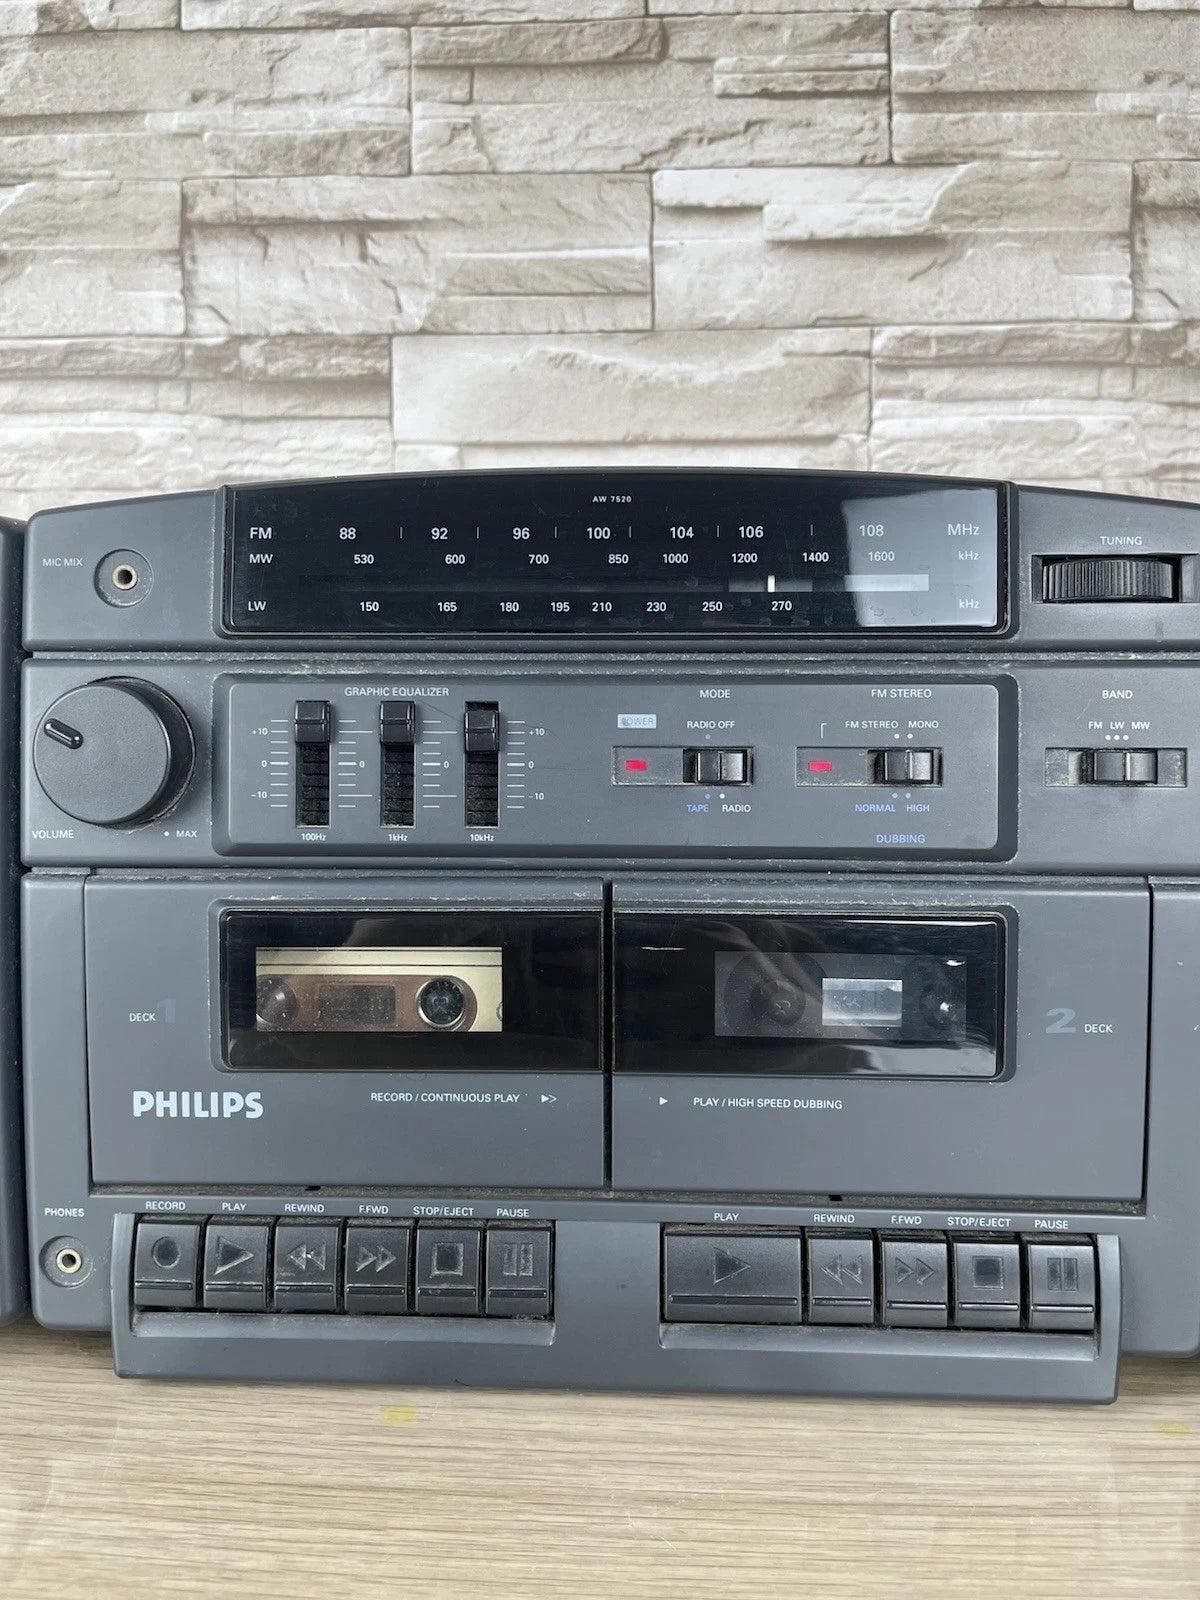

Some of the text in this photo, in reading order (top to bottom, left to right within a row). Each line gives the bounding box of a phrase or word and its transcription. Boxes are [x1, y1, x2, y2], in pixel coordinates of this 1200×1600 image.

[593, 495, 632, 503] AW 7520
[250, 524, 979, 539] FM 88 92 96 100 104 106 108 MHz
[1100, 536, 1142, 546] TUNING
[43, 557, 83, 567] MIC MIX
[250, 550, 981, 564] MW 530 600 700 850 1000 1200 1400 1600 kHz
[248, 598, 980, 612] LW 150 165 180 195 210 230 250 270 kHz
[345, 686, 450, 697] GRAPHIC EQUALIZER
[700, 688, 731, 699] MODE
[872, 688, 932, 699] FM STEREO
[1103, 689, 1134, 700] BAND
[687, 720, 736, 729] RADIO OFF
[846, 720, 899, 729] FM STEREO
[909, 720, 940, 729] MONO
[1089, 720, 1151, 730] FM LW MW
[261, 759, 268, 768] 0
[359, 760, 365, 768] 0
[443, 760, 450, 769] 0
[528, 760, 535, 769] 0
[687, 803, 709, 813] TAPE
[722, 804, 752, 813] RADIO
[855, 803, 896, 813] NORMAL
[907, 803, 930, 813] HIGH
[32, 829, 75, 840] VOLUME
[177, 829, 198, 838] MAX
[301, 832, 327, 841] 100Hz
[389, 833, 408, 842] 1kHz
[470, 833, 495, 842] 10kHz
[877, 833, 926, 844] DUBBING
[129, 999, 176, 1023] DECK 1
[1045, 1009, 1113, 1034] 2 DECK
[371, 1092, 413, 1102] RECORD
[421, 1092, 489, 1103] CONTINUOUS
[491, 1093, 520, 1103] PLAY
[694, 1096, 721, 1107] PLAY
[728, 1097, 755, 1108] HIGH
[757, 1098, 792, 1108] SPEED
[794, 1099, 842, 1109] DUBBING
[133, 1091, 263, 1118] PHILIPS
[145, 1200, 187, 1211] RECORD
[222, 1201, 247, 1212] PLAY
[285, 1203, 325, 1213] REWIND
[359, 1204, 389, 1215] F.FWD
[45, 1207, 85, 1218] PHONES
[413, 1206, 474, 1216] STOP/EJECT
[497, 1207, 530, 1218] PAUSE
[714, 1212, 740, 1222] PLAY
[813, 1213, 857, 1224] REWIND
[891, 1214, 923, 1225] F.FWD
[947, 1217, 1011, 1227] STOP/EJECT
[1033, 1219, 1069, 1230] PAUSE
